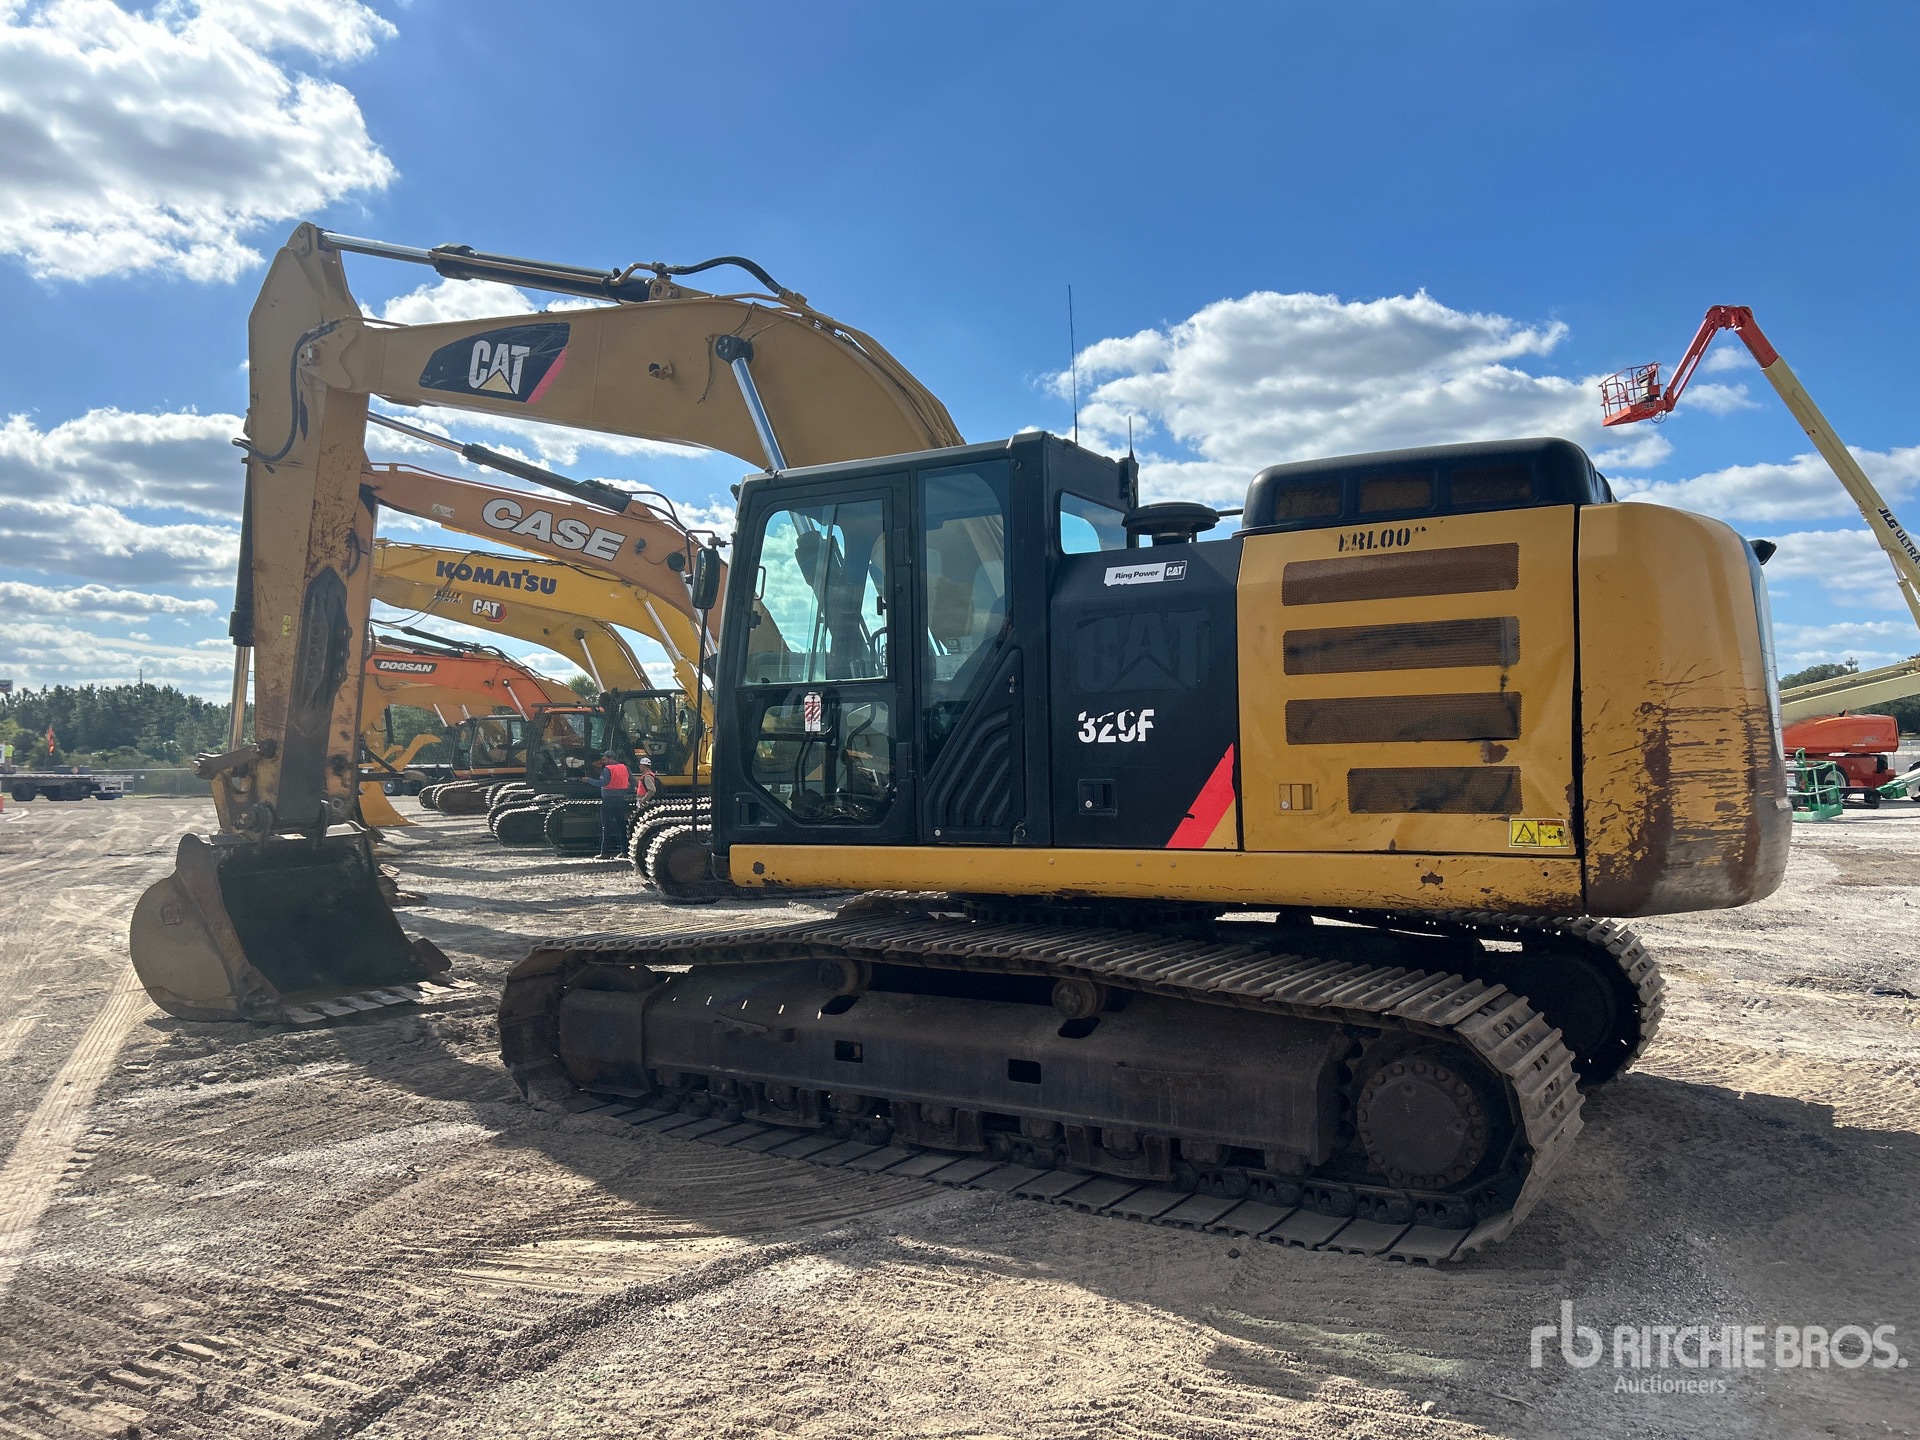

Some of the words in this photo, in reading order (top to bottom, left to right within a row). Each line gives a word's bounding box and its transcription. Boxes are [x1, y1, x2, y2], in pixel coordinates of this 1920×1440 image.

[468, 340, 530, 395] CAT
[482, 498, 626, 561] CASE
[1877, 508, 1899, 530] JLG
[1895, 529, 1920, 564] ULTRA
[436, 560, 557, 594] KOMATSU
[1115, 571, 1132, 579] Ring
[1166, 565, 1184, 576] CAT
[472, 599, 500, 618] CAT
[380, 661, 432, 672] DOOSAN
